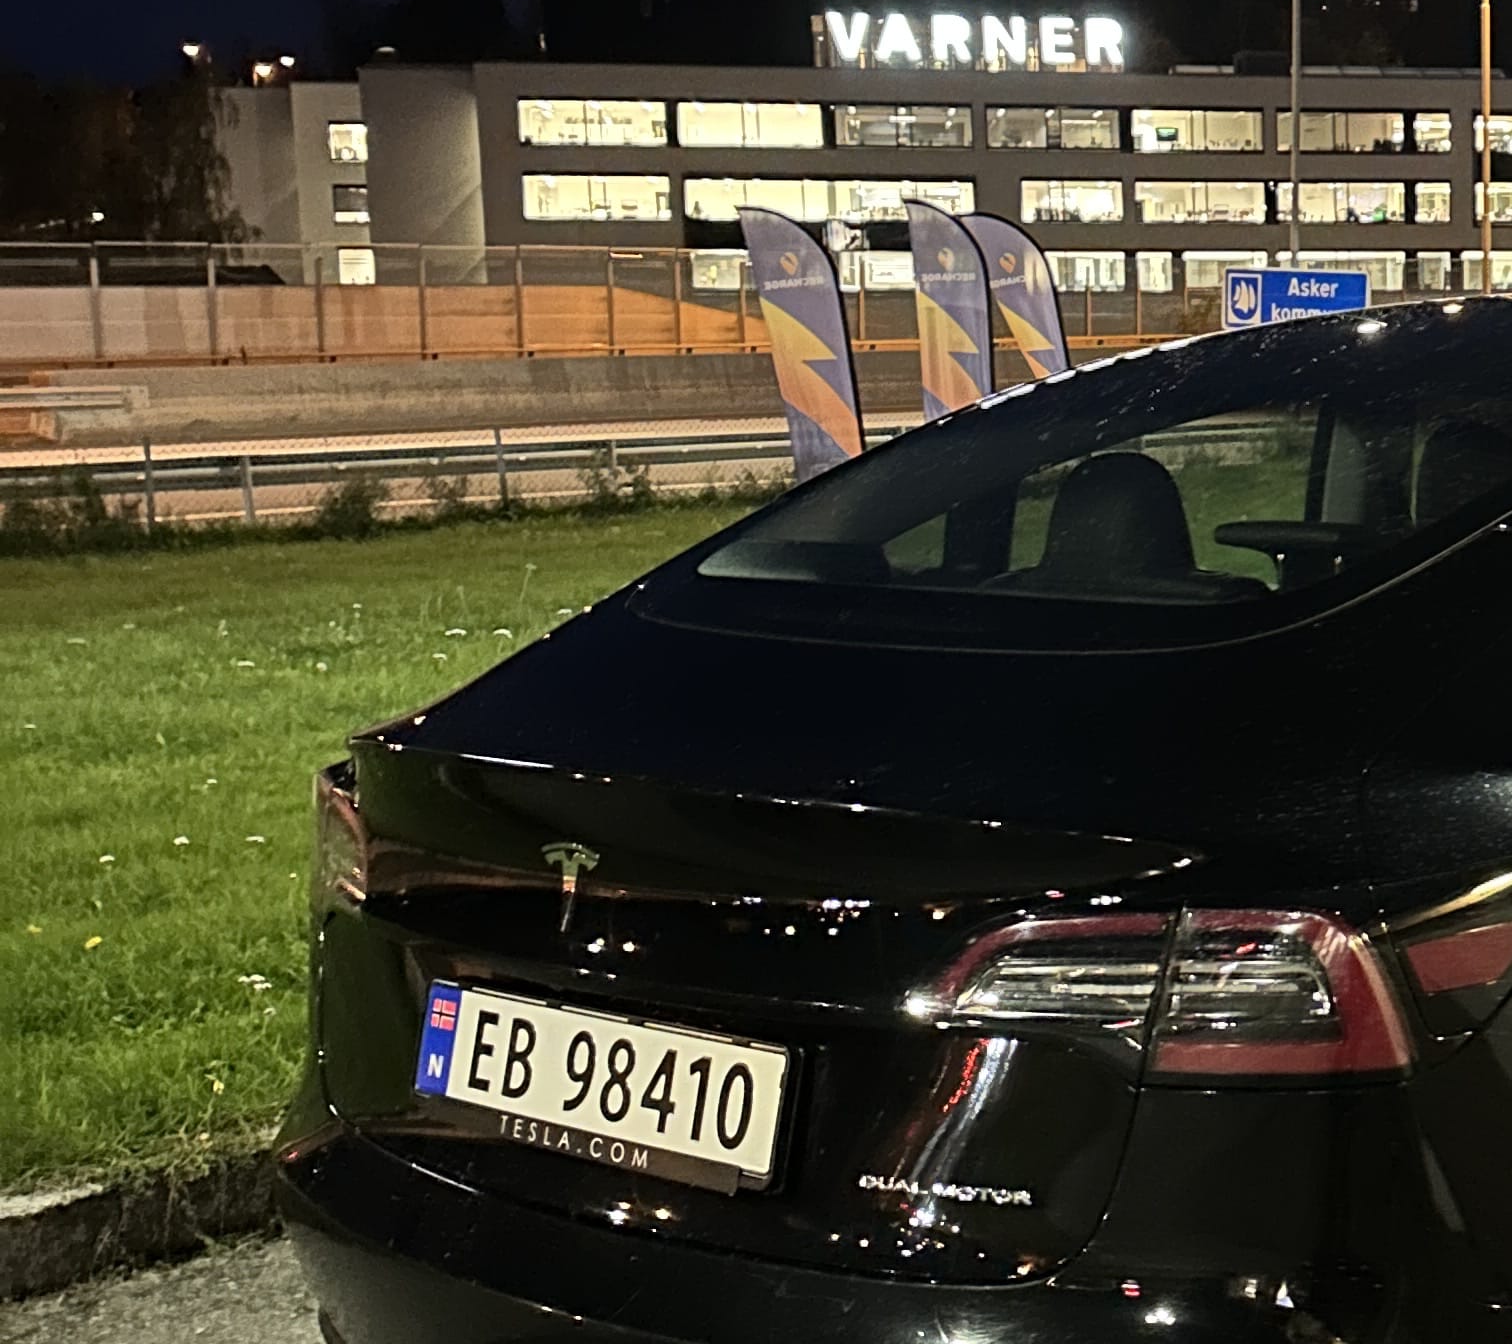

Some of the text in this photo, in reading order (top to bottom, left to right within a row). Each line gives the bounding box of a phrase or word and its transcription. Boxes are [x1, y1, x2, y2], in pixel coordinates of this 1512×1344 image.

[825, 11, 1125, 66] VARNER
[1287, 276, 1339, 298] Asker
[427, 1053, 443, 1079] N
[468, 1010, 754, 1150] EB 98410
[500, 1114, 650, 1169] TESLA.COM
[858, 1175, 1033, 1206] DUAL MOTOR
